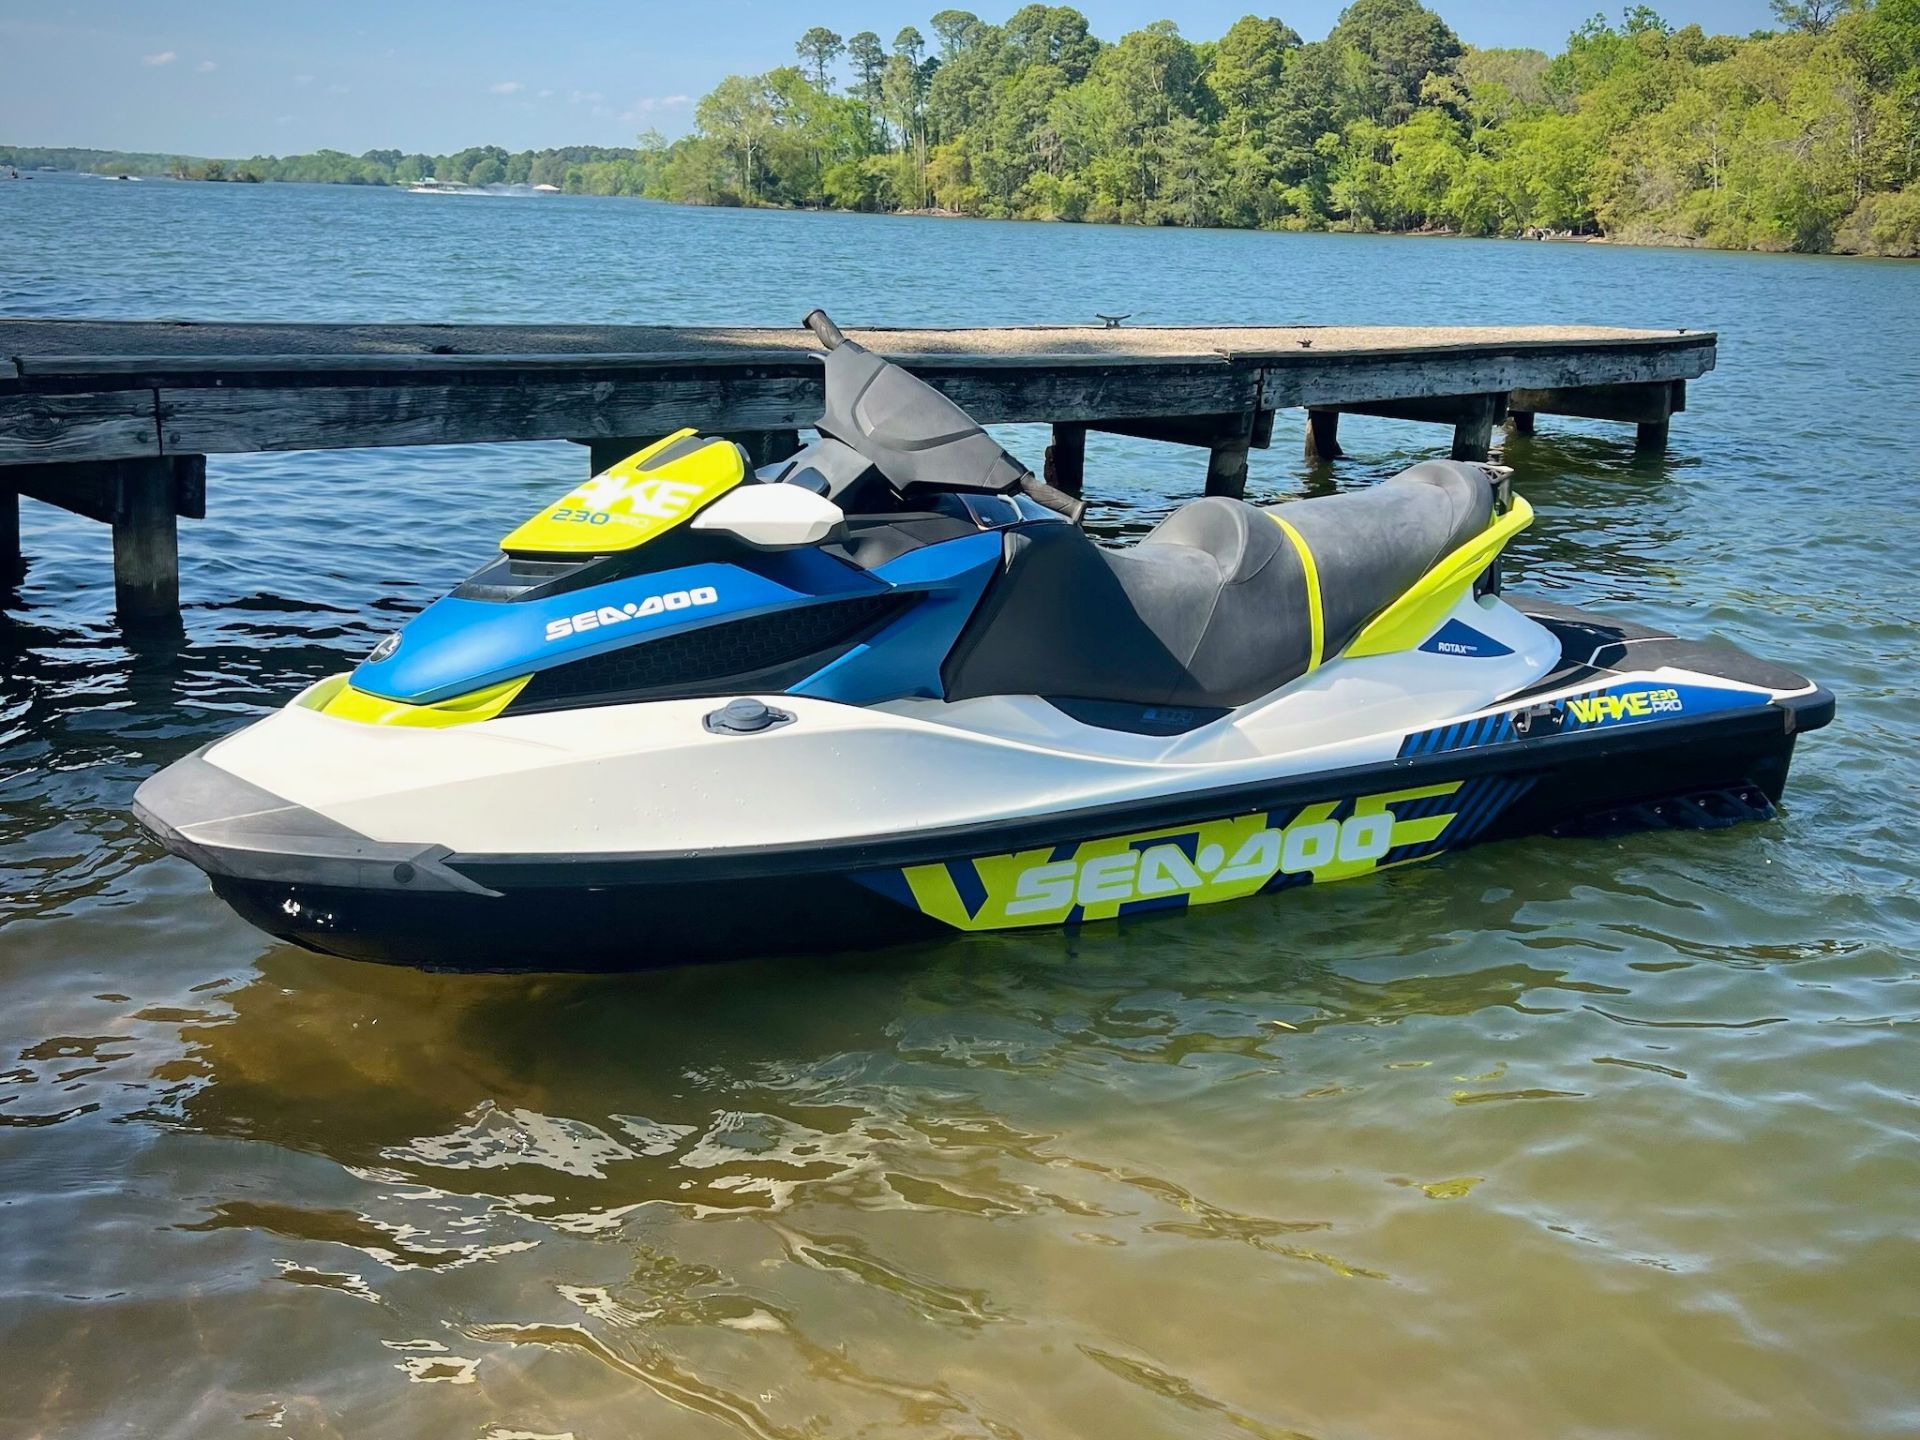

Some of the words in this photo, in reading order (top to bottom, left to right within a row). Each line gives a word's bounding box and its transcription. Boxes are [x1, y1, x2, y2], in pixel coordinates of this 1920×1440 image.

[551, 508, 609, 525] 230
[1438, 641, 1467, 654] ROTAX
[1565, 691, 1653, 724] WAKE
[1649, 688, 1679, 701] 230
[1651, 698, 1683, 714] PRO
